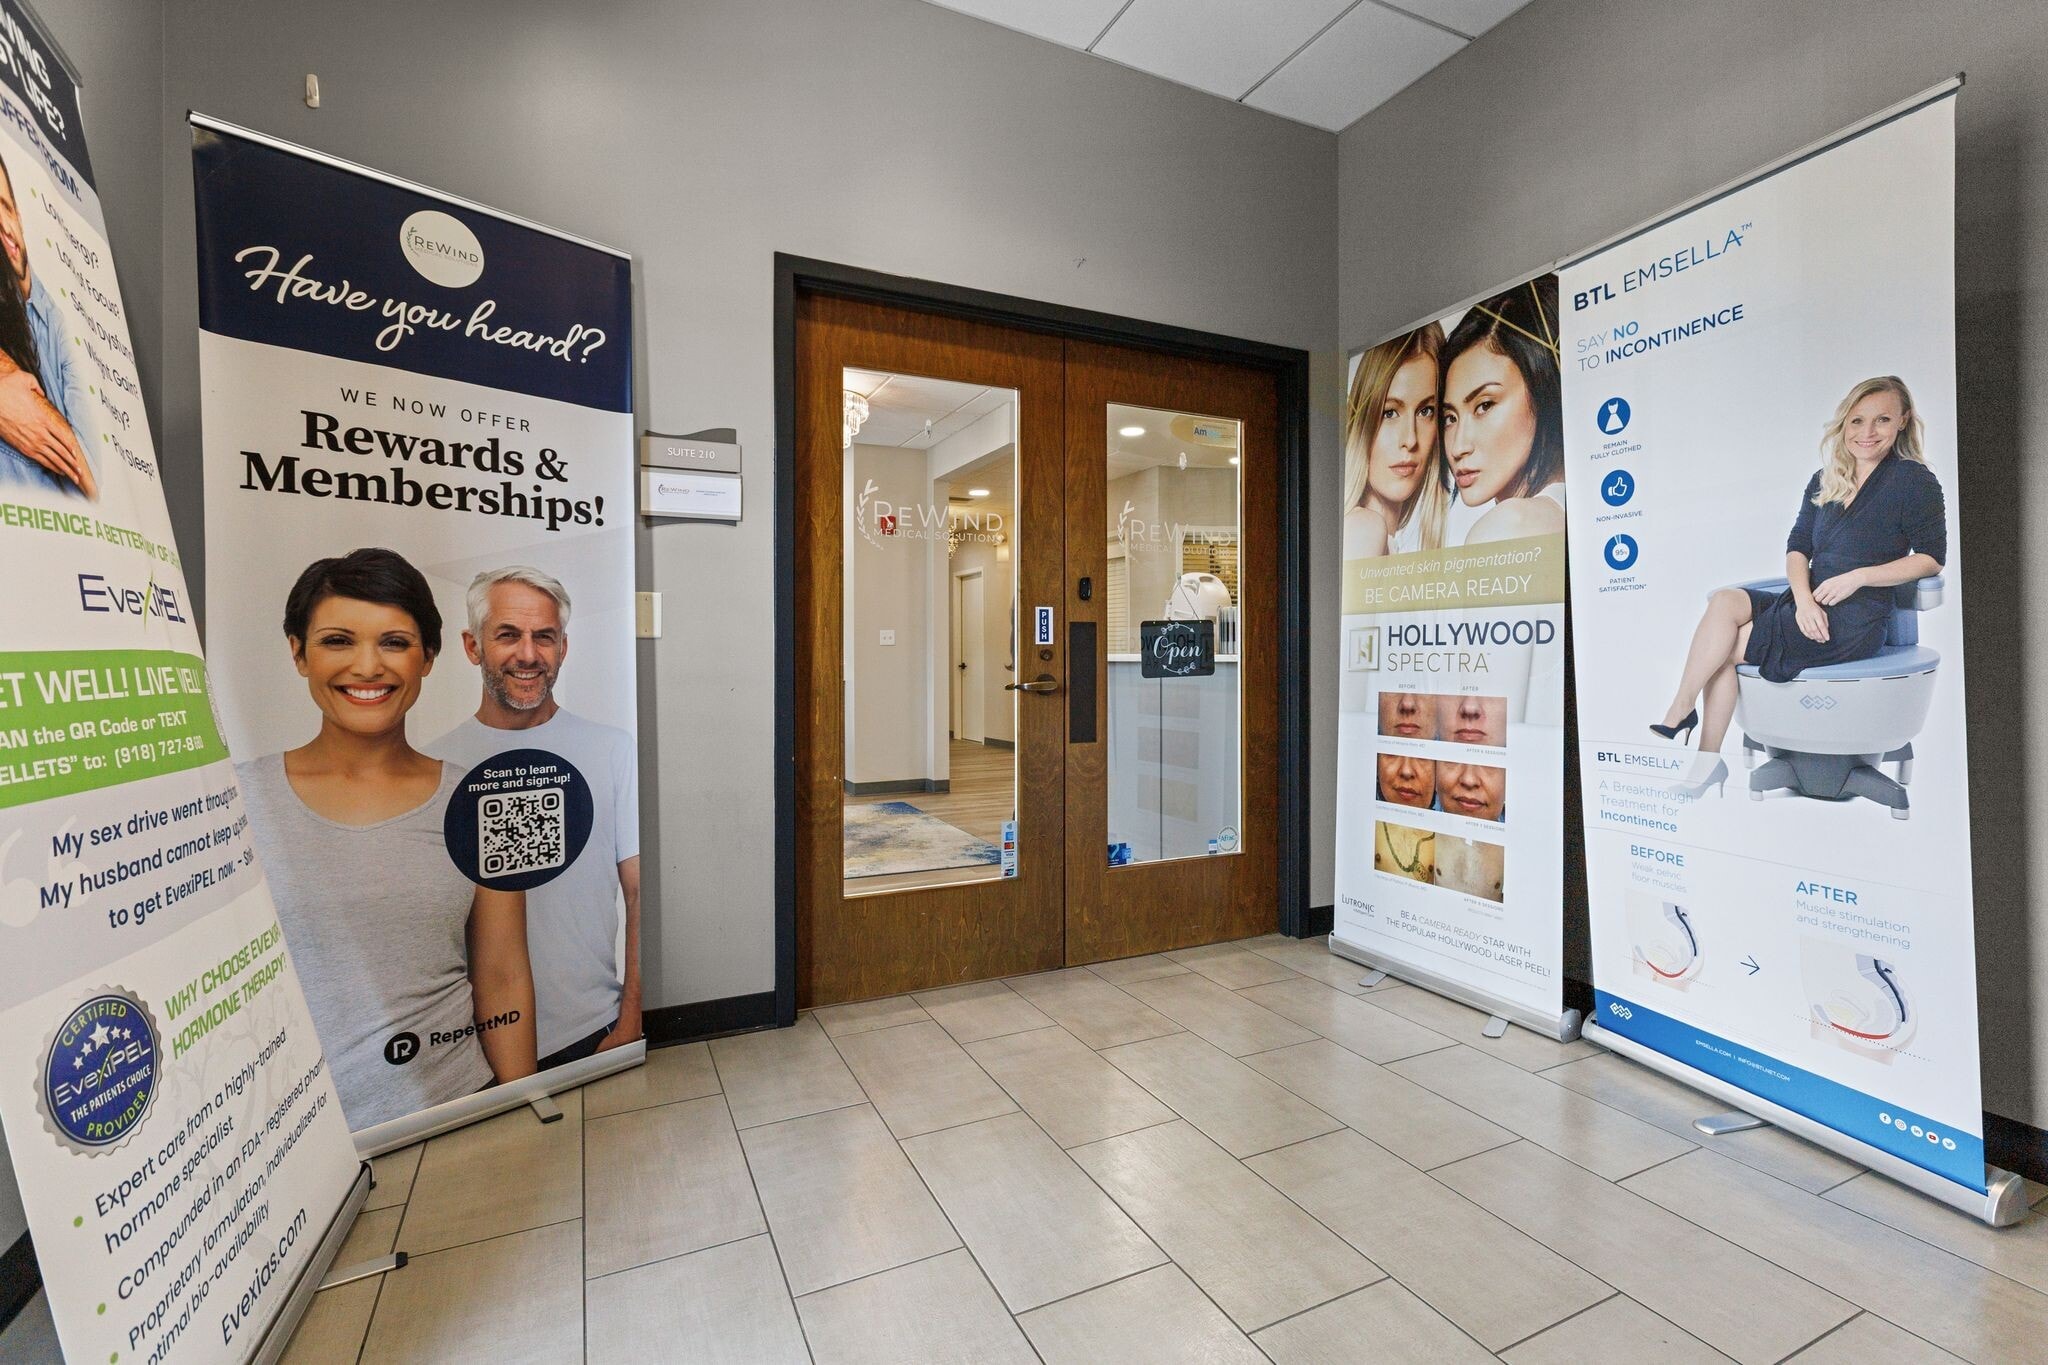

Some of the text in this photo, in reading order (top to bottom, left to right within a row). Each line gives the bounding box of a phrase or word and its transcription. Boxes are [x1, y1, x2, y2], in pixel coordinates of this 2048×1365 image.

[17, 58, 67, 141] LIFE?
[235, 245, 606, 363] Have you heard?
[1573, 283, 1616, 311] BTL
[1577, 321, 1639, 353] SAY NO
[1578, 304, 1744, 371] TO INCONTINENCE
[340, 387, 530, 432] WE NOW OFFER
[301, 410, 569, 482] Rewards &
[668, 447, 716, 459] SUITE 210
[1590, 444, 1642, 461] FULLY CLOTHED
[1603, 440, 1627, 450] REMAIN
[239, 450, 605, 531] Memberships!
[96, 522, 104, 541] A
[873, 528, 928, 540] MEDICAL
[1596, 511, 1642, 523] NON-INVASIVE
[1360, 546, 1542, 579] Unwanted skin pigmentation?
[1365, 575, 1532, 604] BE CAMERA READY
[1040, 611, 1048, 641] PUSH
[1388, 620, 1555, 647] HOLLYWOOD
[1153, 635, 1203, 664] Open
[34, 667, 129, 704] WELL!
[134, 666, 175, 696] LIVE
[33, 726, 66, 746] the
[69, 720, 97, 741] QR
[100, 716, 138, 736] Code
[141, 716, 156, 731] or
[158, 710, 187, 729] TEXT
[82, 753, 107, 770] to:
[115, 744, 156, 768] (918)
[483, 765, 557, 779] Scan to learn
[1597, 752, 1621, 763] BTL
[468, 773, 571, 792] more and sign-up!
[1599, 780, 1694, 804] A Breakthrough
[1600, 810, 1678, 832] Incontinence
[1601, 795, 1680, 817] Treatment for
[52, 833, 84, 858] My
[90, 823, 122, 846] sex
[128, 810, 168, 836] drive
[172, 797, 204, 822] went
[40, 883, 73, 909] My
[80, 848, 162, 894] husband
[167, 833, 211, 864] cannot
[213, 826, 232, 847] keep
[1631, 845, 1684, 867] BEFORE
[109, 861, 236, 929] to get EvexiPEL now.
[1796, 881, 1858, 905] AFTER
[1400, 910, 1531, 958] BE A CAMERA READY STAR WITH
[1796, 900, 1910, 934] Muscle stimulation
[1796, 914, 1911, 950] and strengthening
[1386, 917, 1551, 978] THE POPULAR HOLLYWOOD LASER PEEL!
[165, 979, 197, 1020] WHY
[201, 945, 251, 994] CHOOSE
[172, 952, 287, 1059] HORMONE THERAPY?
[62, 1002, 127, 1046] CERTIFIED
[430, 1010, 520, 1046] RepeatMD
[71, 1064, 151, 1123] THE PATIENTS CHOICE
[86, 1090, 147, 1137] PROVIDER
[95, 1027, 287, 1218] Expert care from a highly-trained
[104, 1115, 234, 1254] hormone specialist
[117, 1185, 211, 1300] Compounded
[212, 1173, 224, 1195] in
[226, 1158, 241, 1179] an
[241, 1130, 264, 1165] FDA-
[265, 1081, 304, 1136] registered
[128, 1249, 201, 1351] Proprietary
[202, 1174, 267, 1256] formulation,
[265, 1101, 316, 1182] individualized
[317, 1091, 327, 1111] for
[192, 1200, 270, 1312] bio-availability
[221, 1208, 308, 1345] Evexias.com
